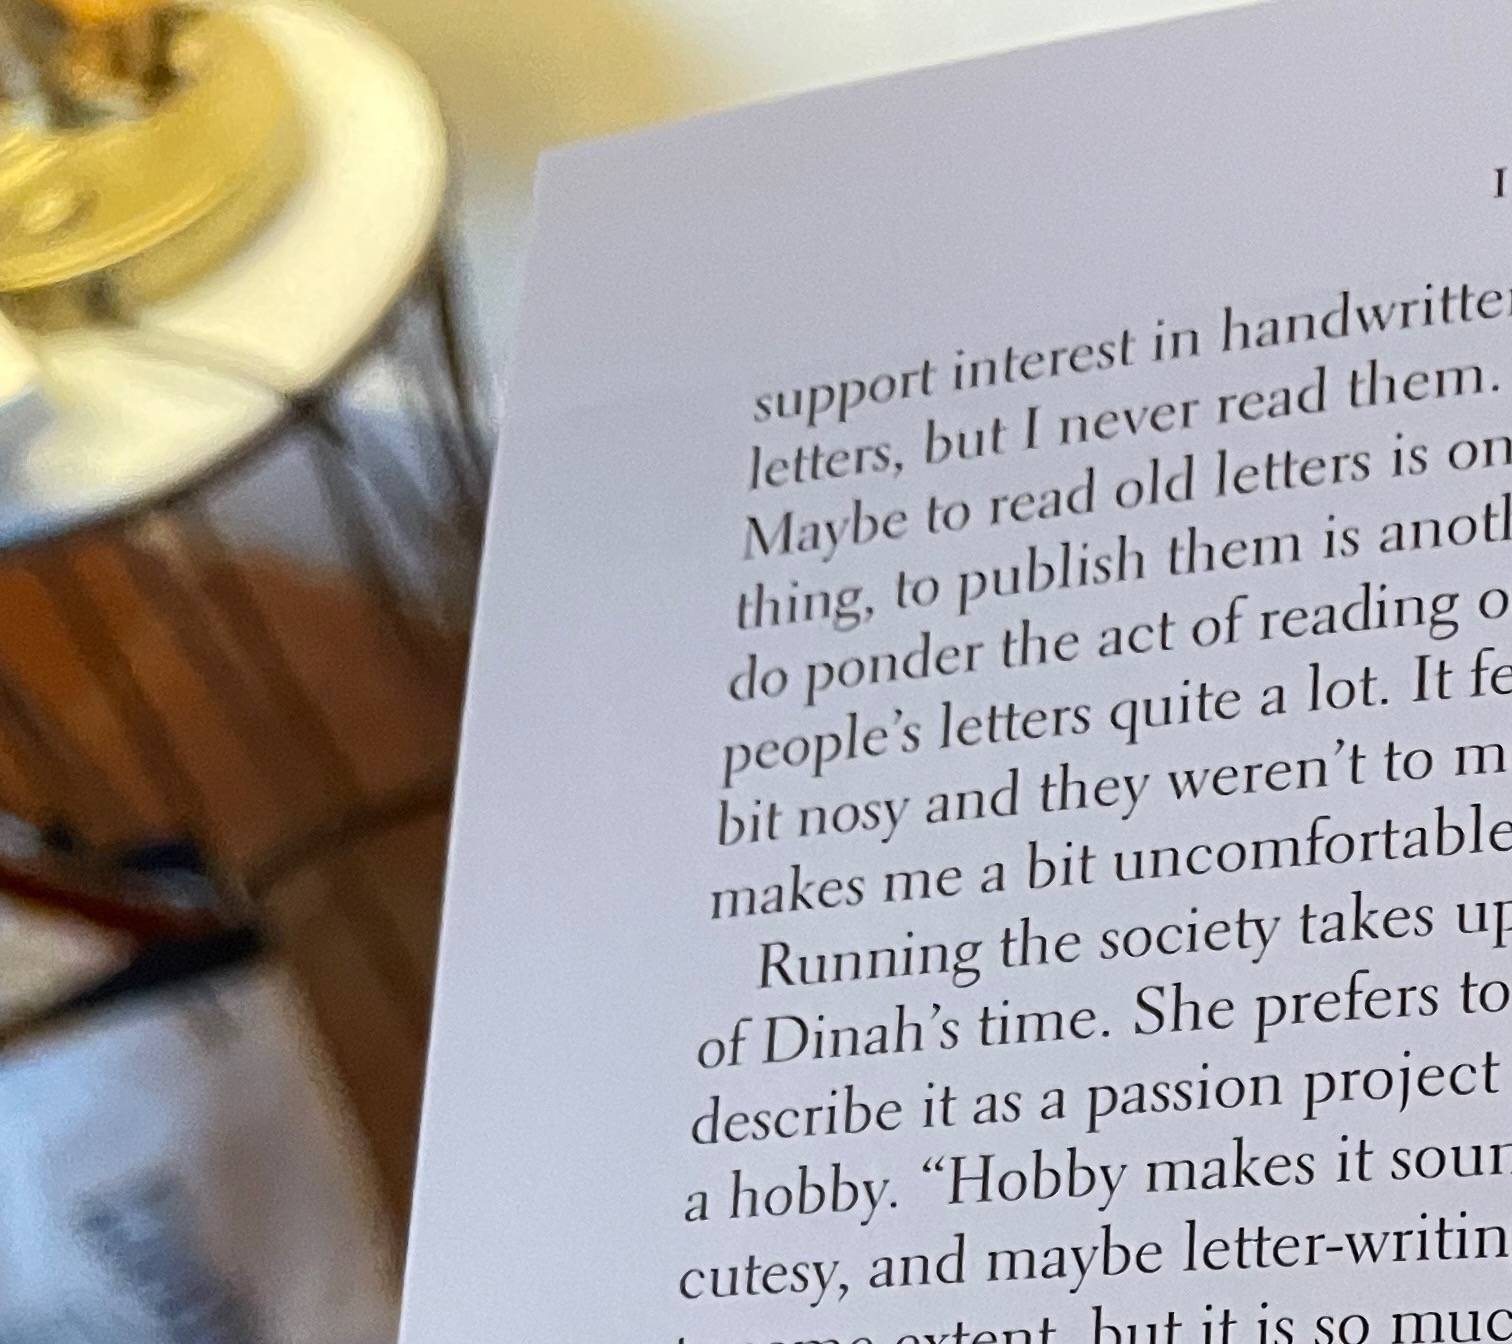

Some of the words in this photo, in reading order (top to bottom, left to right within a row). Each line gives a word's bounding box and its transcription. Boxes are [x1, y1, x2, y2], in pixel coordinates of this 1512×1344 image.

[753, 359, 933, 428] support
[954, 329, 1130, 391] interest
[1154, 319, 1199, 362] in
[745, 498, 907, 563] Maybe
[928, 496, 971, 534] to
[990, 466, 1095, 525] read
[1115, 453, 1194, 508] old
[1216, 448, 1370, 497] letters
[1392, 432, 1428, 477] is
[760, 930, 983, 989] Running
[1000, 916, 1081, 968] the
[1100, 906, 1281, 965] society
[1299, 889, 1434, 945] takes
[691, 1084, 903, 1145] describe
[922, 1081, 958, 1128] it
[973, 1091, 1022, 1125] as
[1040, 1088, 1066, 1120] a
[1085, 1062, 1283, 1134] passion
[1302, 1049, 1501, 1121] project
[679, 1254, 849, 1309] cutesy,
[868, 1232, 965, 1289] and
[986, 1223, 1163, 1295] maybe
